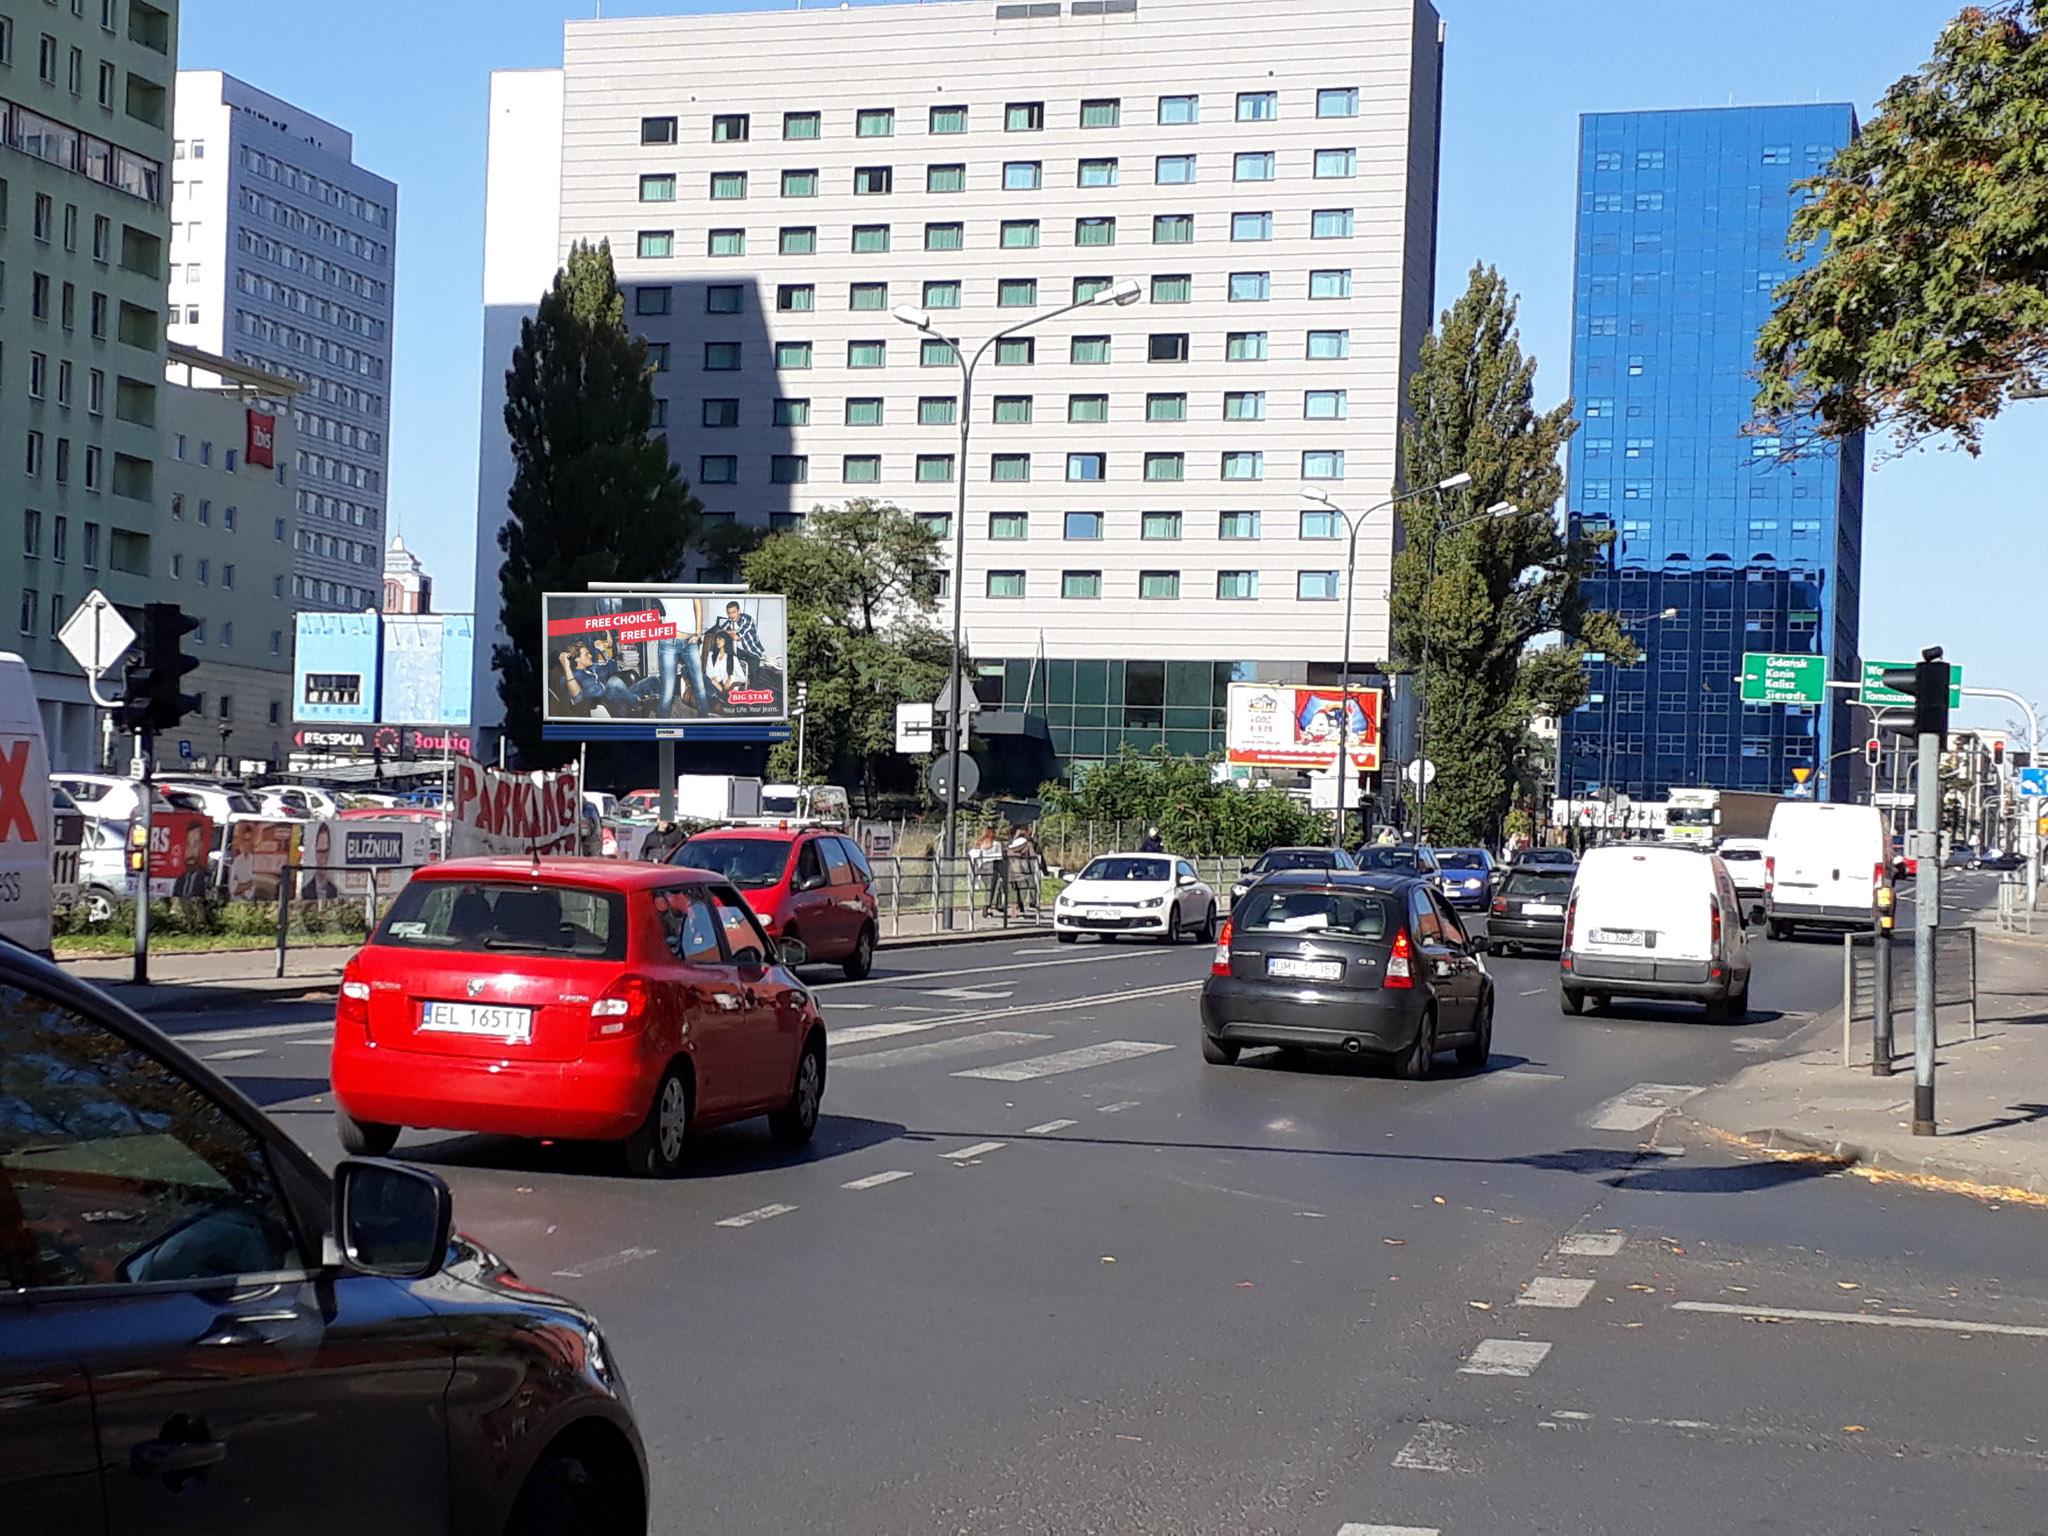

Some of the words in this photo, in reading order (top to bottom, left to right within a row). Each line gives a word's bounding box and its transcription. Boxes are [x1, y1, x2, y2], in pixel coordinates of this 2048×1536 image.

[253, 424, 272, 449] ibis
[585, 617, 612, 629] FREE
[613, 612, 656, 625] CHOICE.
[620, 630, 646, 641] FREE
[648, 626, 674, 637] LIFE!
[1765, 668, 1796, 678] Konin
[1765, 679, 1796, 689] Kalisz
[748, 693, 769, 701] STAR
[1765, 690, 1808, 701] Sieradz
[762, 705, 779, 713] Jeans.
[304, 733, 364, 746] RECEPCJA
[457, 764, 577, 839] PARKING
[347, 834, 401, 858] BLIŹNIUK
[435, 1006, 459, 1025] EL
[471, 1008, 526, 1030] 165TT
